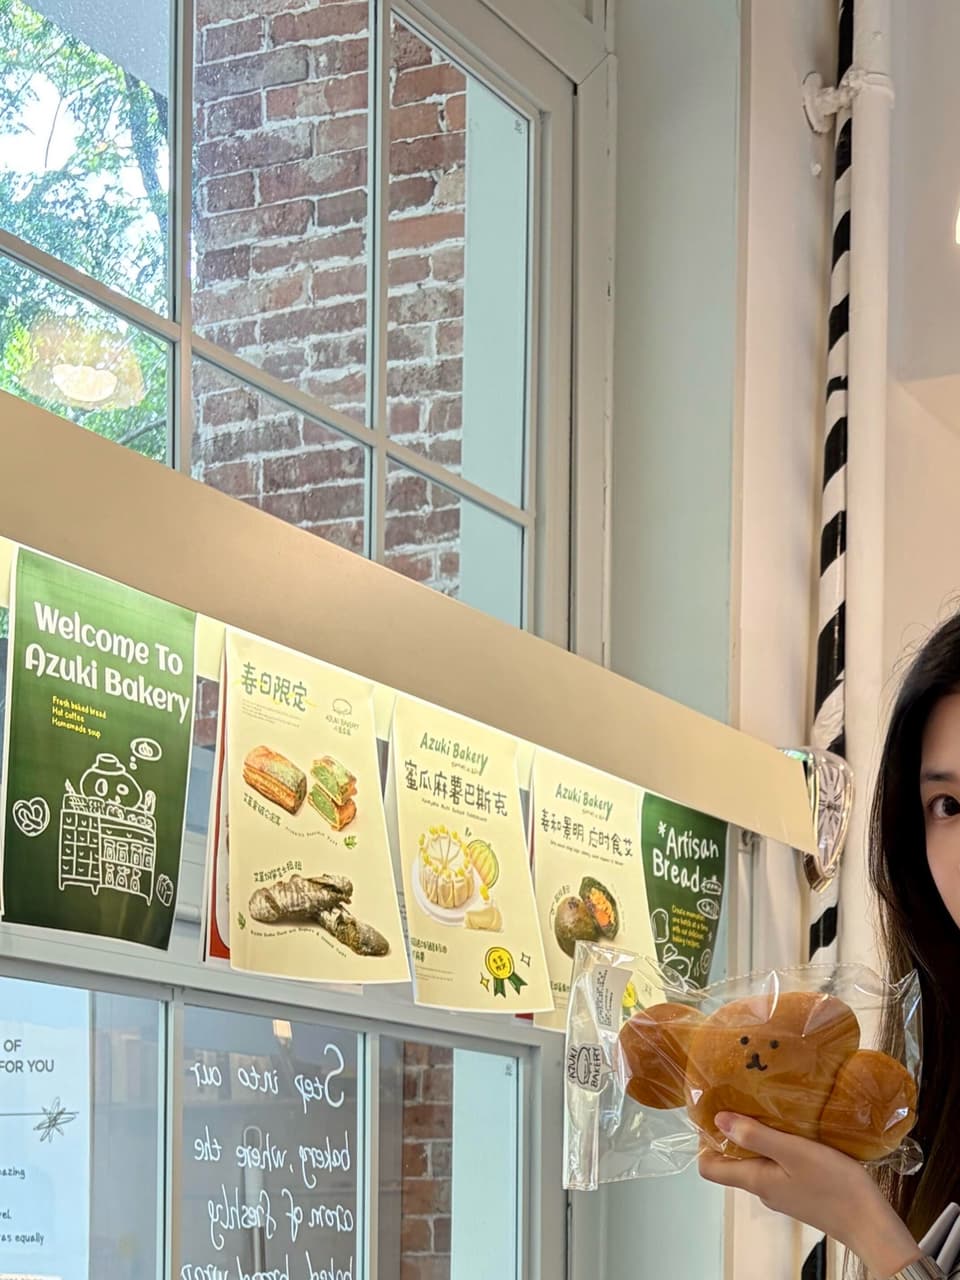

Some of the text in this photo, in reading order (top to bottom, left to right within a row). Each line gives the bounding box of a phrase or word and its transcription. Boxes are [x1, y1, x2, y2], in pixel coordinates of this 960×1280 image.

[34, 601, 184, 676] Welcome To
[25, 643, 98, 690] Azuki
[105, 667, 190, 724] Bakery
[241, 661, 308, 713] 春日限定
[52, 696, 107, 719] Fresh baked bread
[52, 707, 85, 723] Hot coffee
[52, 717, 87, 734] Homemade
[419, 731, 451, 756] Azuki
[452, 742, 489, 777] Bakery
[404, 759, 508, 816] 蜜瓜麻薯巴斯克
[555, 783, 582, 804] Azuki
[582, 791, 613, 822] Bakery
[665, 827, 720, 861] Artisan
[652, 848, 700, 893] Bread
[3, 1039, 22, 1053] OF
[567, 1047, 577, 1080] AZUKI
[27, 1060, 55, 1073] YOU
[591, 1047, 601, 1089] BAKERY
[15, 1232, 44, 1246] equally
